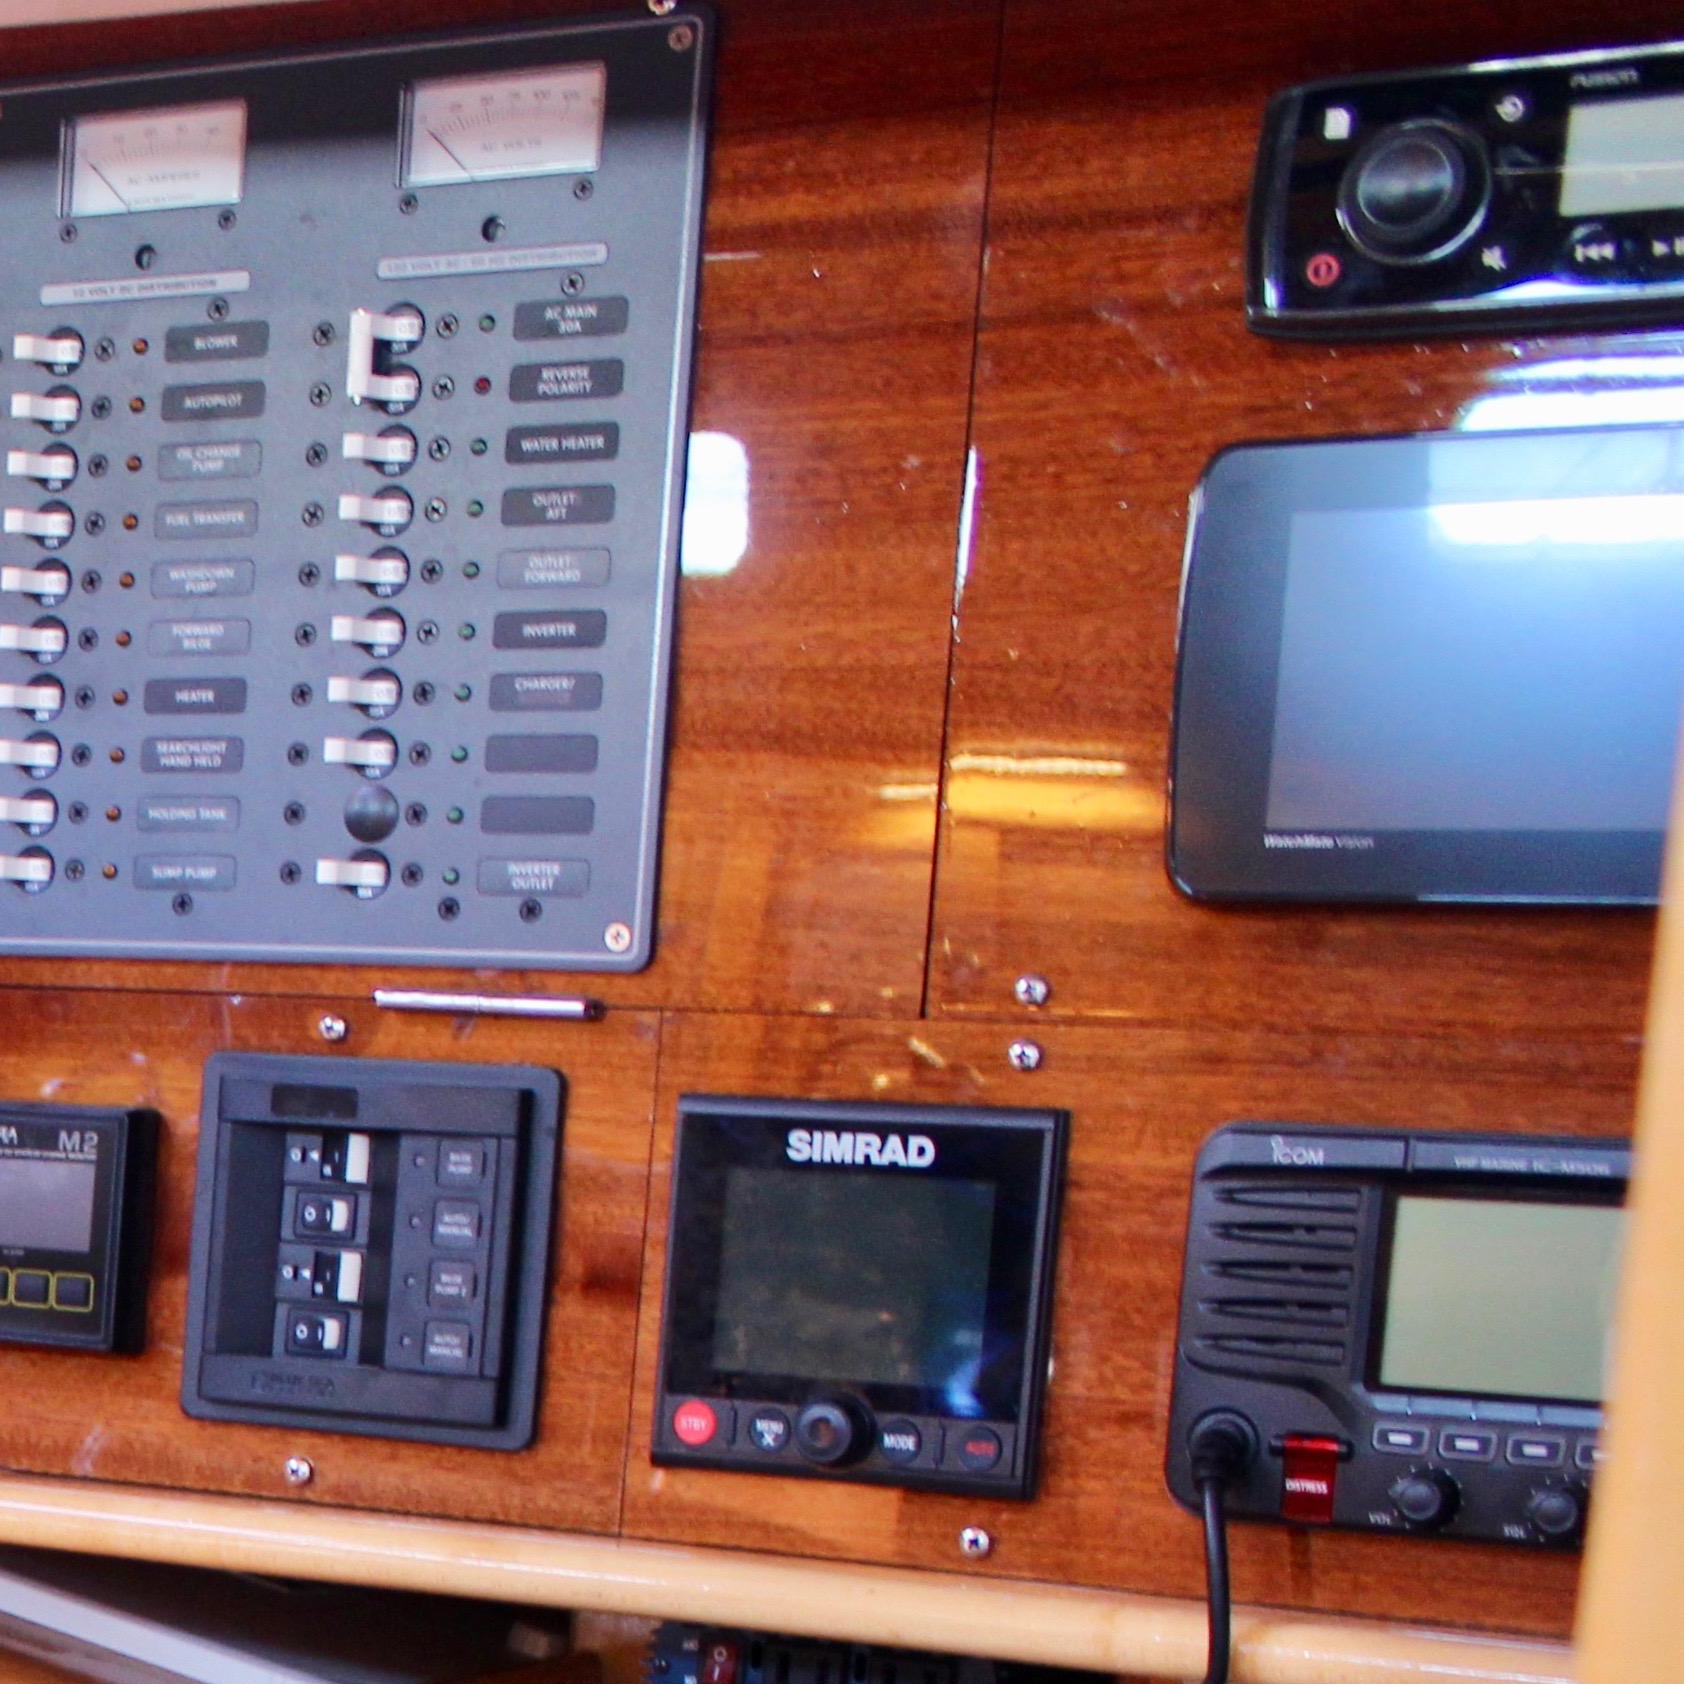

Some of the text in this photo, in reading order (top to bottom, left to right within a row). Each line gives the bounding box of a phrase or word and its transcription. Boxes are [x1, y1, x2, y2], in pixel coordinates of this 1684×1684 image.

[544, 305, 598, 320] AC MAIN
[194, 335, 238, 349] BLOWER
[541, 367, 590, 381] REVERSE
[537, 381, 592, 395] POLARITY
[184, 394, 243, 409] AUTOPILOT
[520, 435, 605, 451] WATER HEATER
[533, 493, 576, 507] OUTLET
[545, 507, 567, 520] AFT
[528, 555, 572, 569] OUTLET
[523, 569, 581, 583] FORWARD
[172, 624, 224, 637] FORWARD
[522, 623, 577, 637] INVERTER
[175, 690, 215, 703] HEATER
[160, 754, 190, 767] HAND
[148, 807, 227, 821] HOLDING TANK
[152, 866, 217, 880] SUMP PUMP
[506, 863, 560, 877] INVERTER
[512, 877, 555, 890] OUTLET
[58, 1130, 99, 1152] M2
[786, 1128, 936, 1168] SIMRAD
[680, 1417, 707, 1432] STBY
[755, 1418, 783, 1434] MENU
[883, 1434, 916, 1452] MODE
[965, 1441, 994, 1456] AUTO
[1285, 1477, 1328, 1495] DISTRESS
